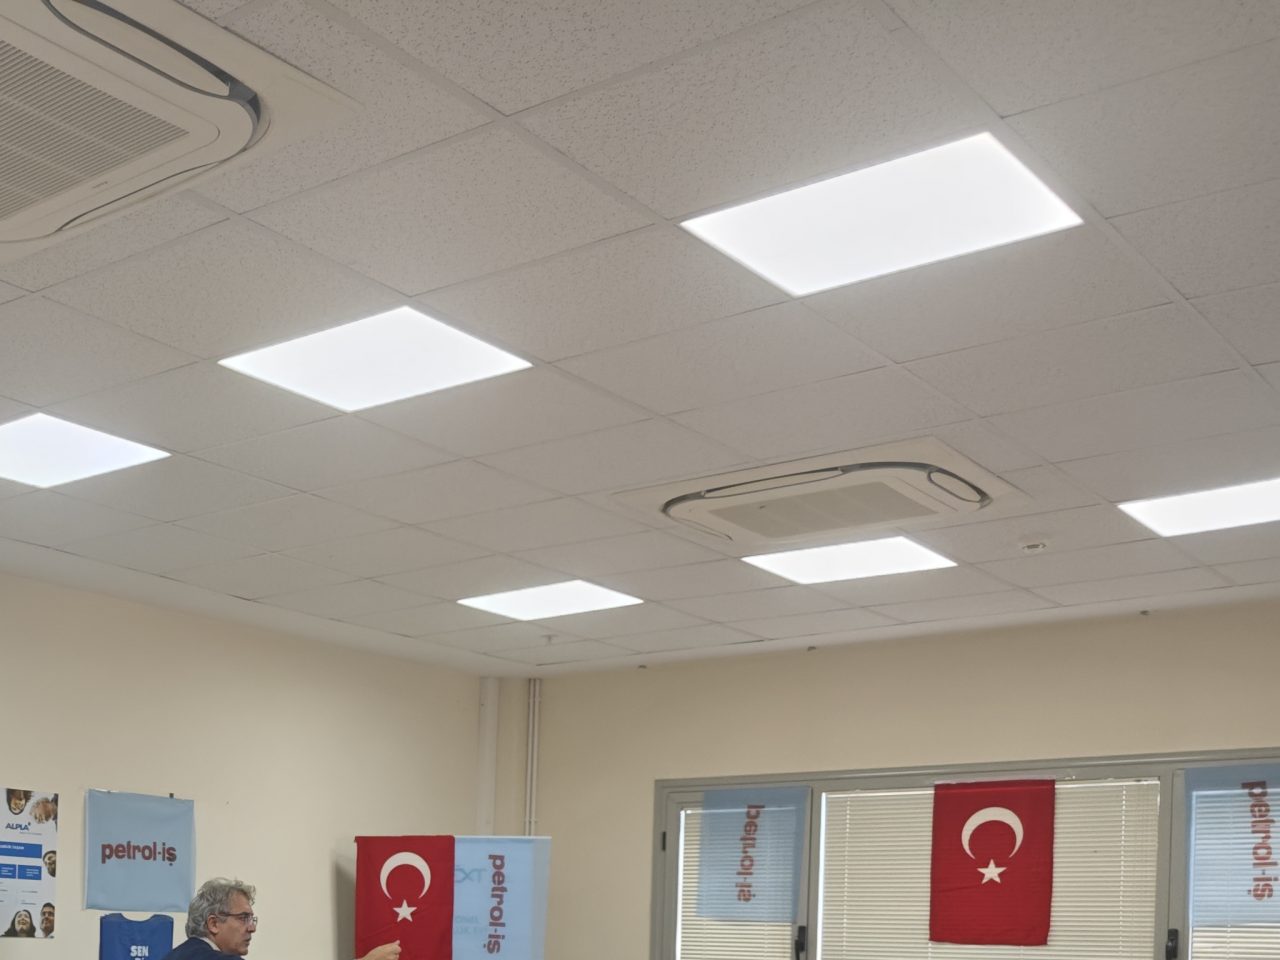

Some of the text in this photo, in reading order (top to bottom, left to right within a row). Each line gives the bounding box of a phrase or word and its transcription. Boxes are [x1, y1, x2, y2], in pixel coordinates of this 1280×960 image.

[5, 822, 29, 831] ALPLA
[101, 840, 177, 867] petrol-iş
[1241, 781, 1279, 901] petrol-iş
[483, 854, 508, 954] petrol-iş
[130, 945, 149, 957] SEN
